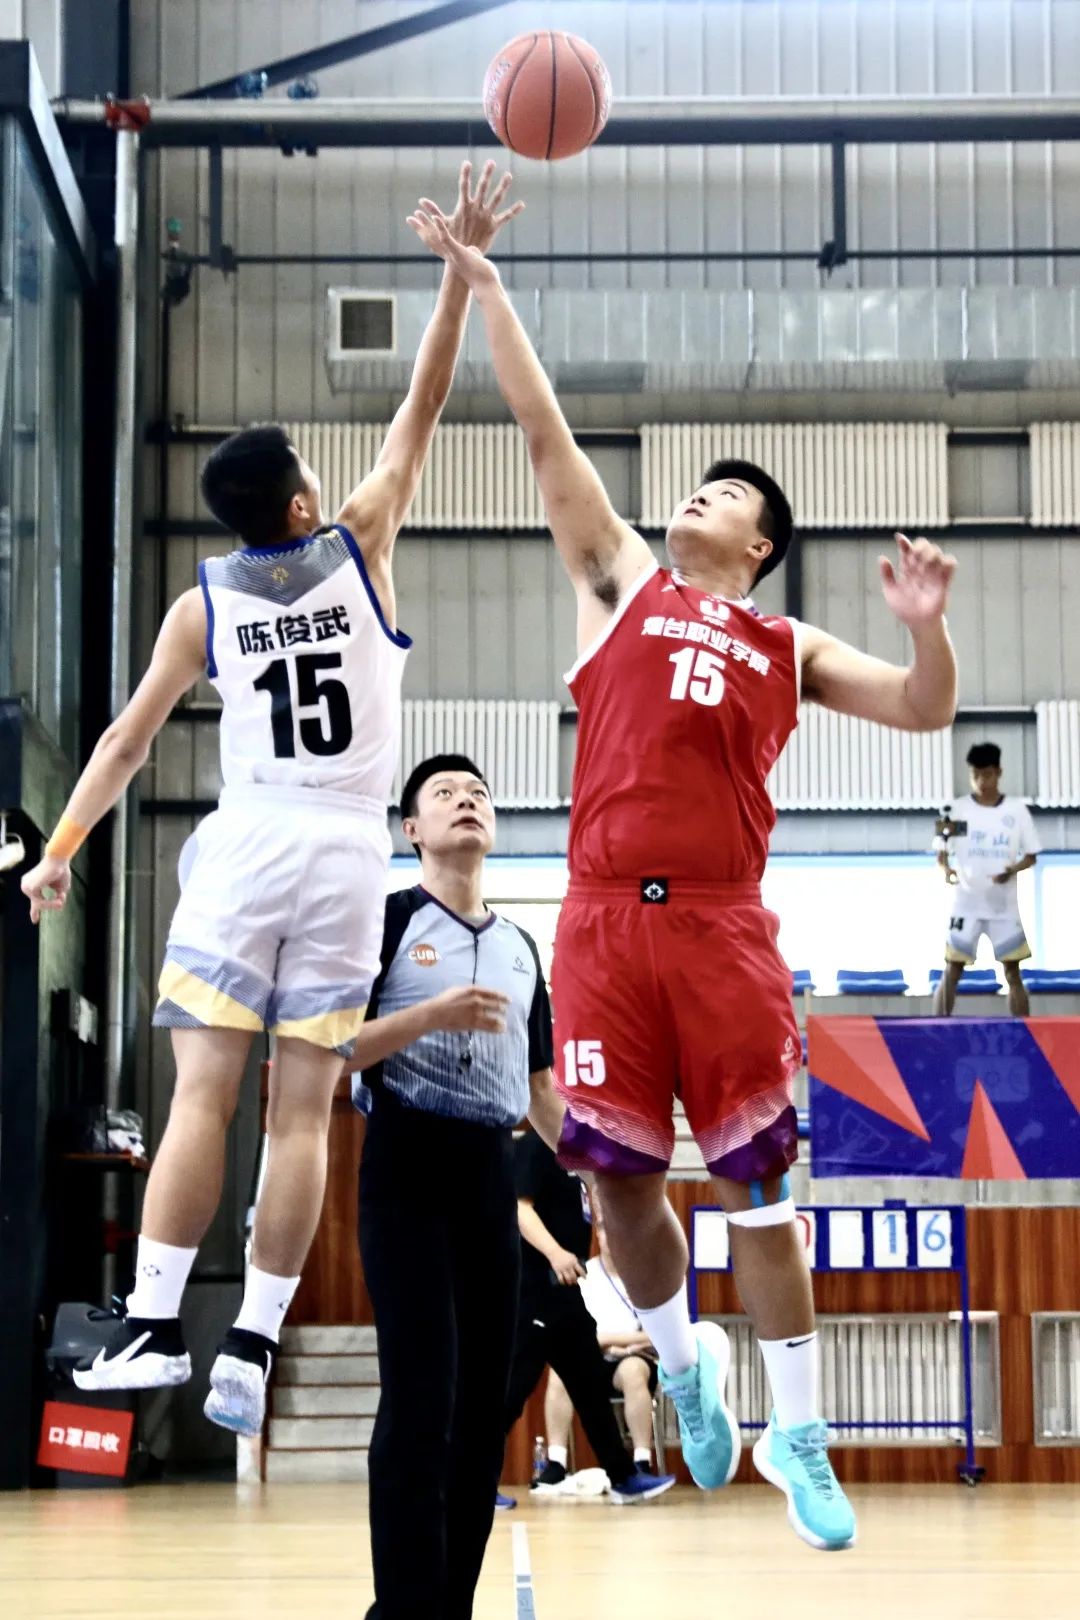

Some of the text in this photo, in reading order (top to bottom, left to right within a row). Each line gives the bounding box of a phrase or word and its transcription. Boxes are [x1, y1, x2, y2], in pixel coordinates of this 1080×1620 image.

[236, 605, 350, 655] 陈俊武
[668, 647, 727, 706] 15
[252, 652, 353, 758] 15
[562, 1040, 606, 1086] 15
